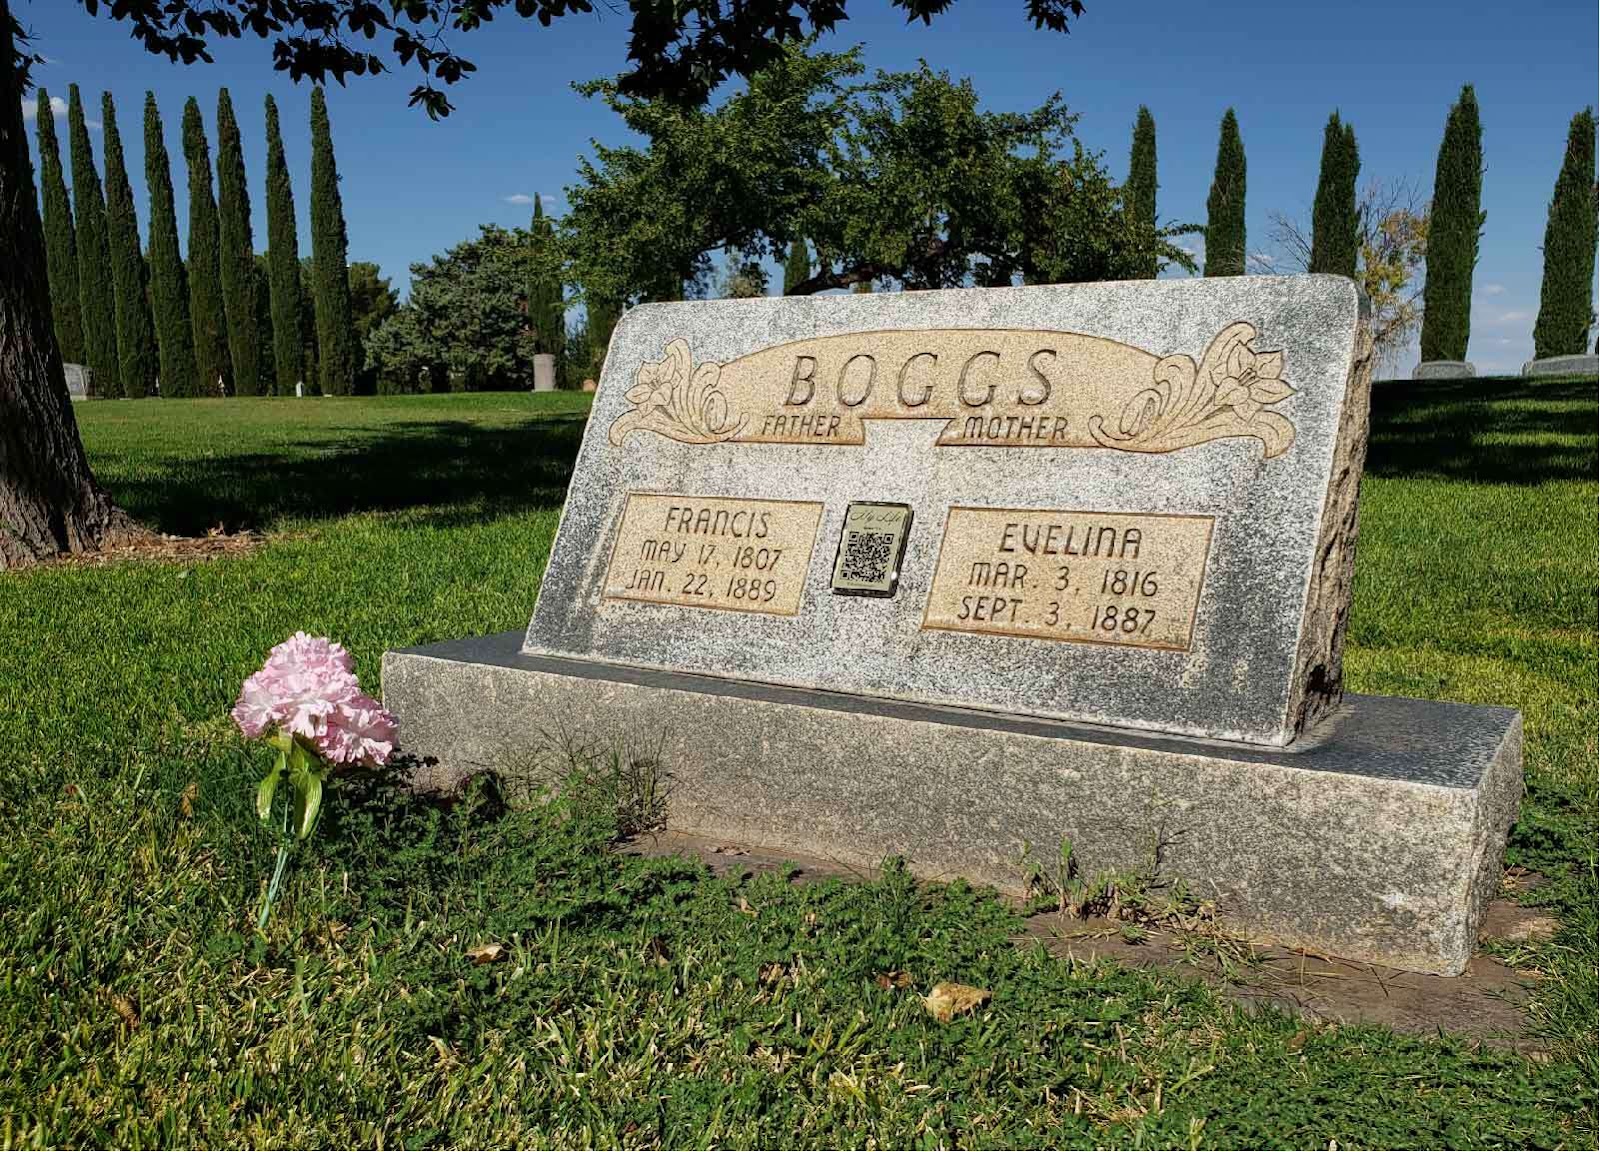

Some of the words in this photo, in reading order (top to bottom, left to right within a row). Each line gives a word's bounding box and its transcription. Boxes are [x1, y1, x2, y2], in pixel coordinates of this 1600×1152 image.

[783, 349, 1057, 407] BOGGS
[762, 415, 841, 437] FATHER
[962, 416, 1069, 440] MOTHER
[664, 507, 771, 538] FRANCIS
[640, 539, 687, 563] MAY
[698, 544, 720, 568] 17,
[733, 546, 783, 572] 1807
[999, 523, 1142, 559] EVELINA
[625, 569, 672, 593] JAN.
[682, 572, 714, 599] 22,
[726, 576, 778, 602] 1889
[968, 562, 1038, 589] MAR.
[1055, 566, 1080, 595] 3,
[1101, 569, 1159, 597] 1816
[957, 596, 1029, 623] SEPT.
[1045, 602, 1071, 629] 3,
[1091, 605, 1156, 634] 1887
